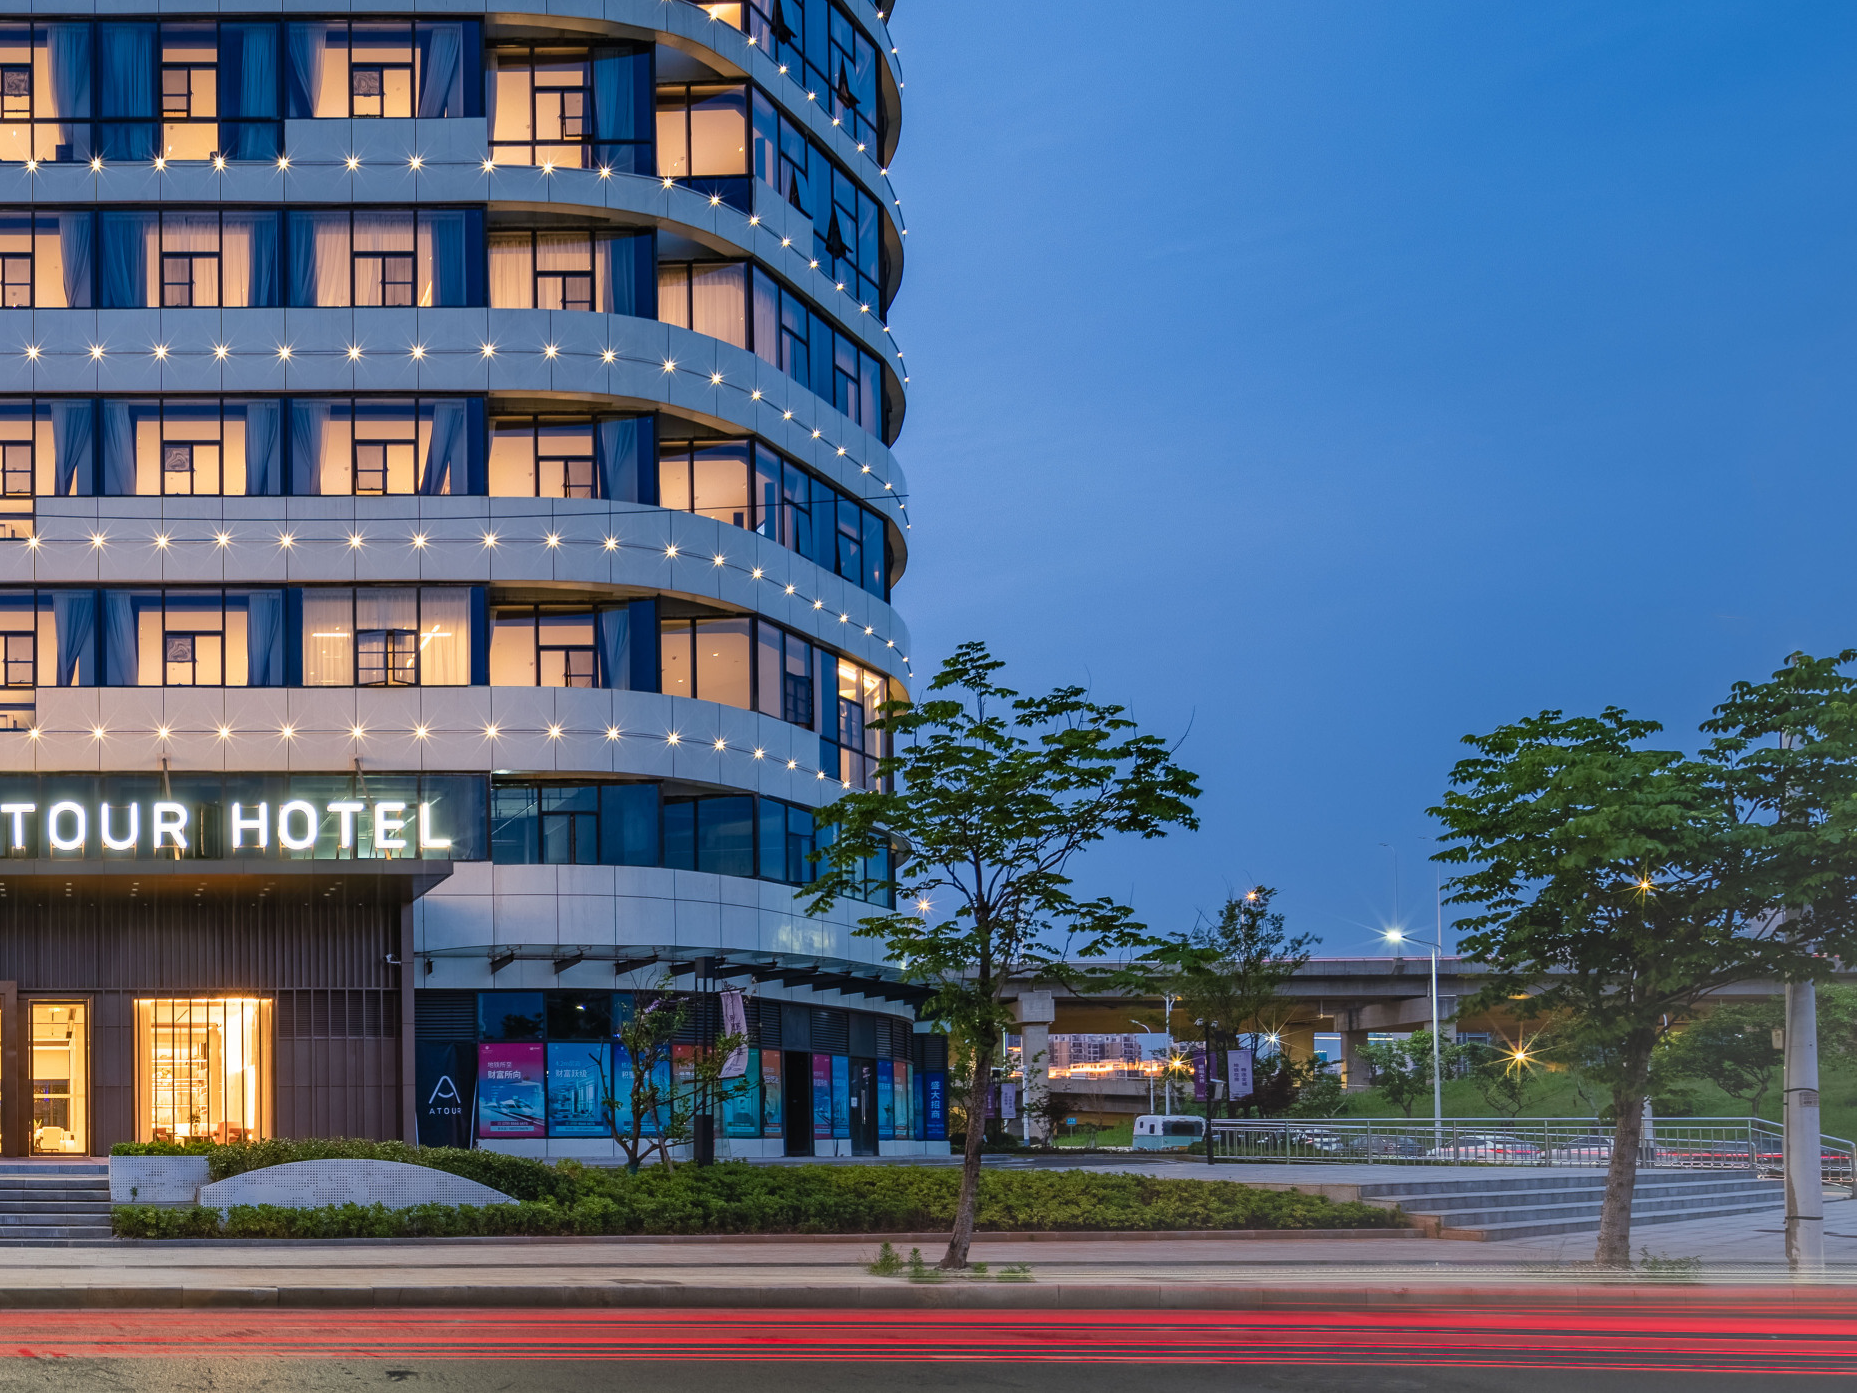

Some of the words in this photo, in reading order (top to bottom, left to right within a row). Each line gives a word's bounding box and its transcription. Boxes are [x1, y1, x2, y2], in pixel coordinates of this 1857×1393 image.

[232, 798, 452, 851] HOTEL
[487, 1070, 522, 1080] 财富所向
[429, 1107, 462, 1115] ATOUR
[930, 1081, 941, 1119] 盛大招商
